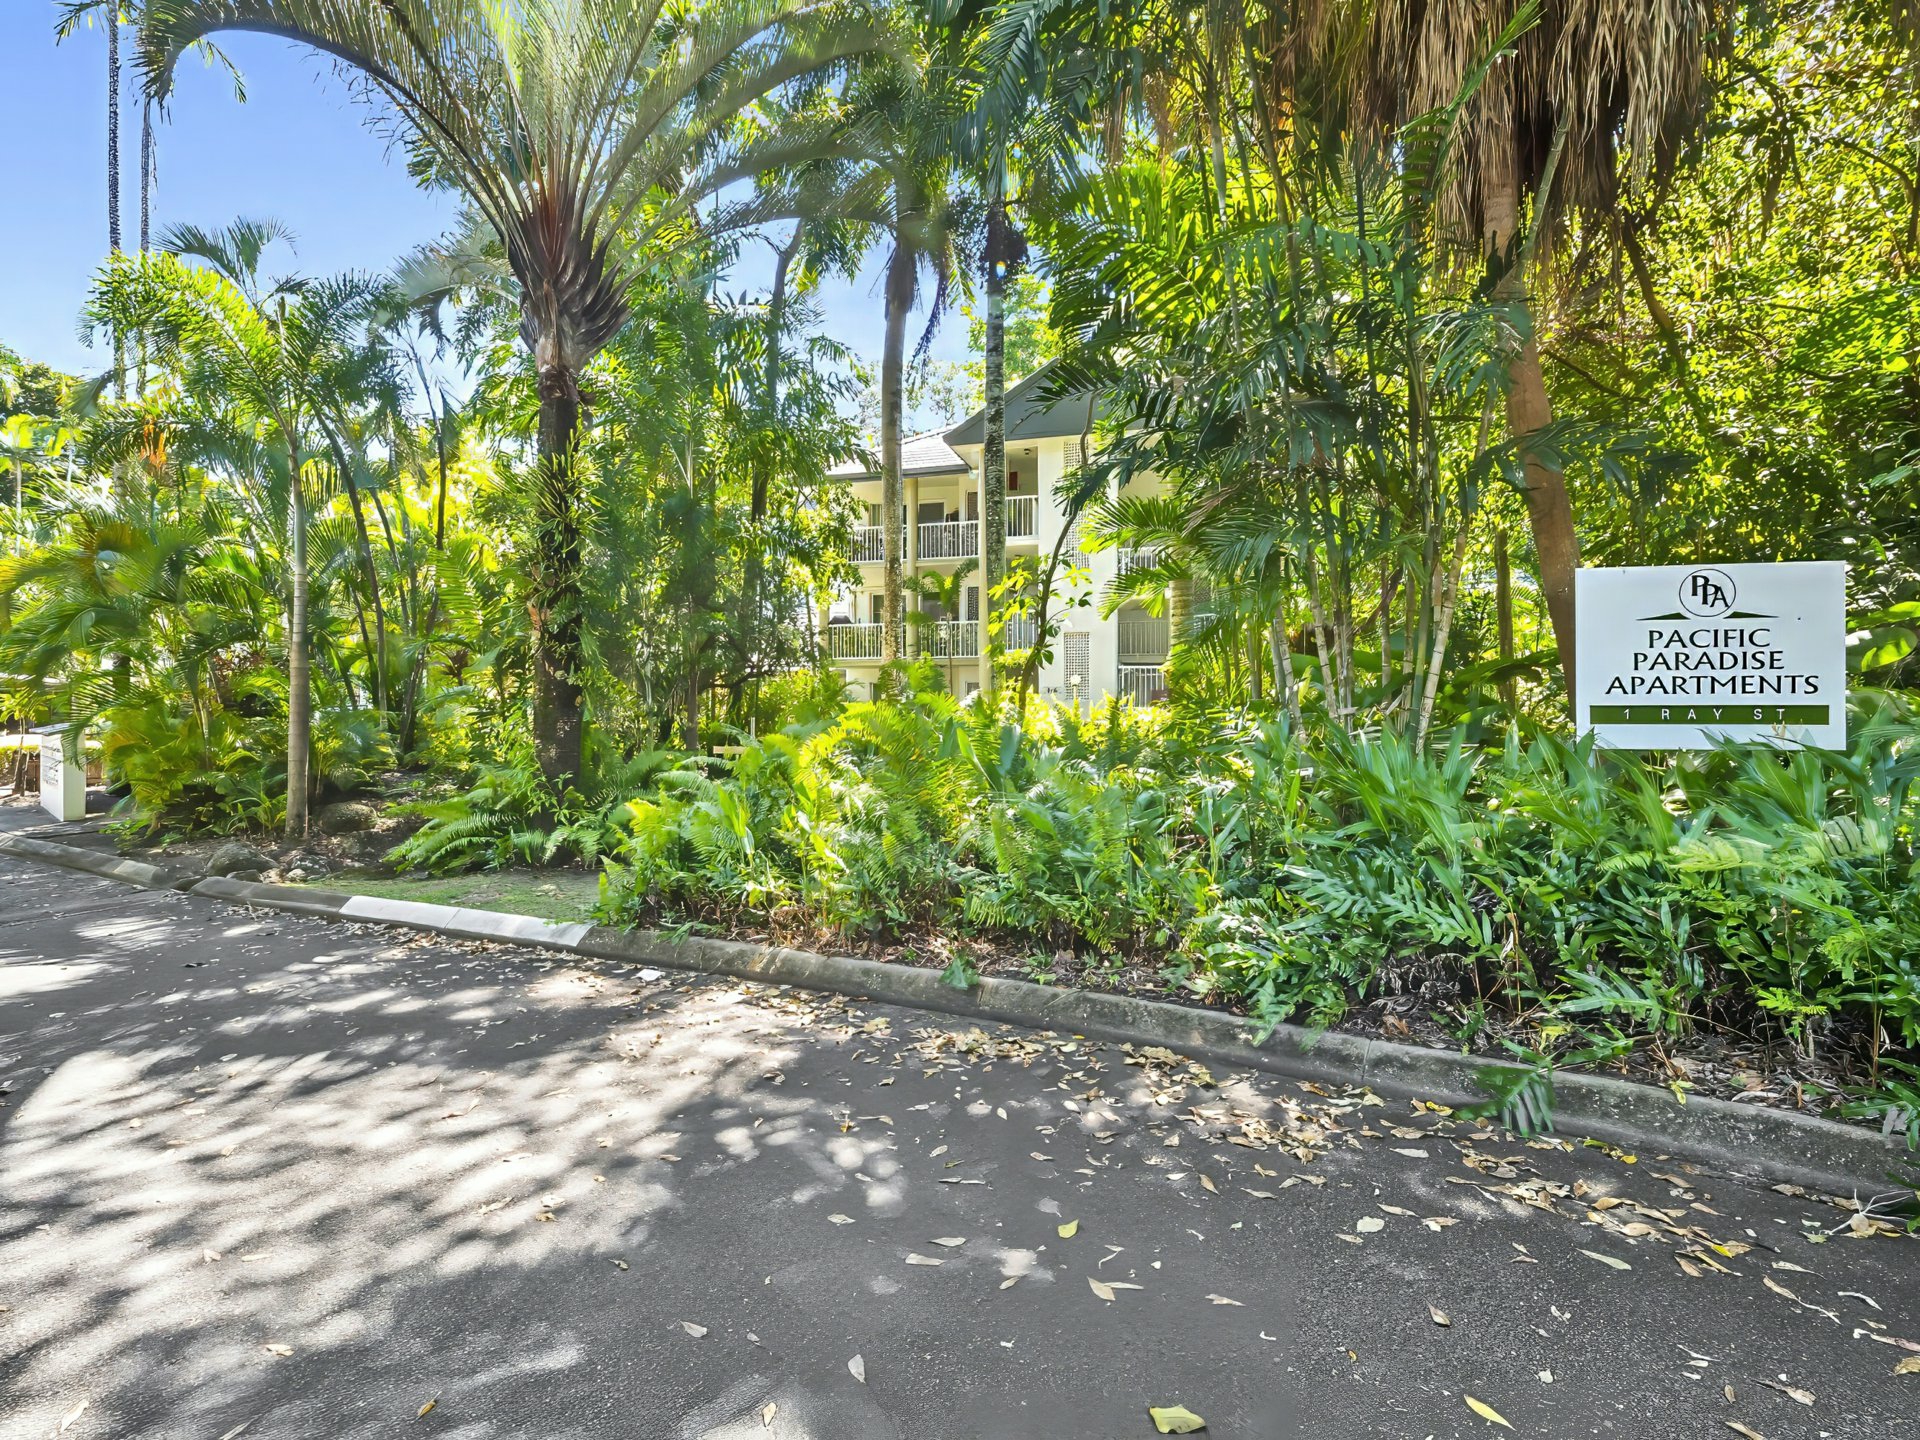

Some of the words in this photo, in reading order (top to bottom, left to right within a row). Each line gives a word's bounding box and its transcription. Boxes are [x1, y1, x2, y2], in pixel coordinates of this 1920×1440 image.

[1648, 628, 1771, 649] PACIFIC
[1633, 650, 1785, 671] PARADISE
[1604, 674, 1819, 695] APARTMENTS
[1623, 708, 1631, 720] 1
[1660, 708, 1723, 720] RAY
[1752, 708, 1786, 720] ST
